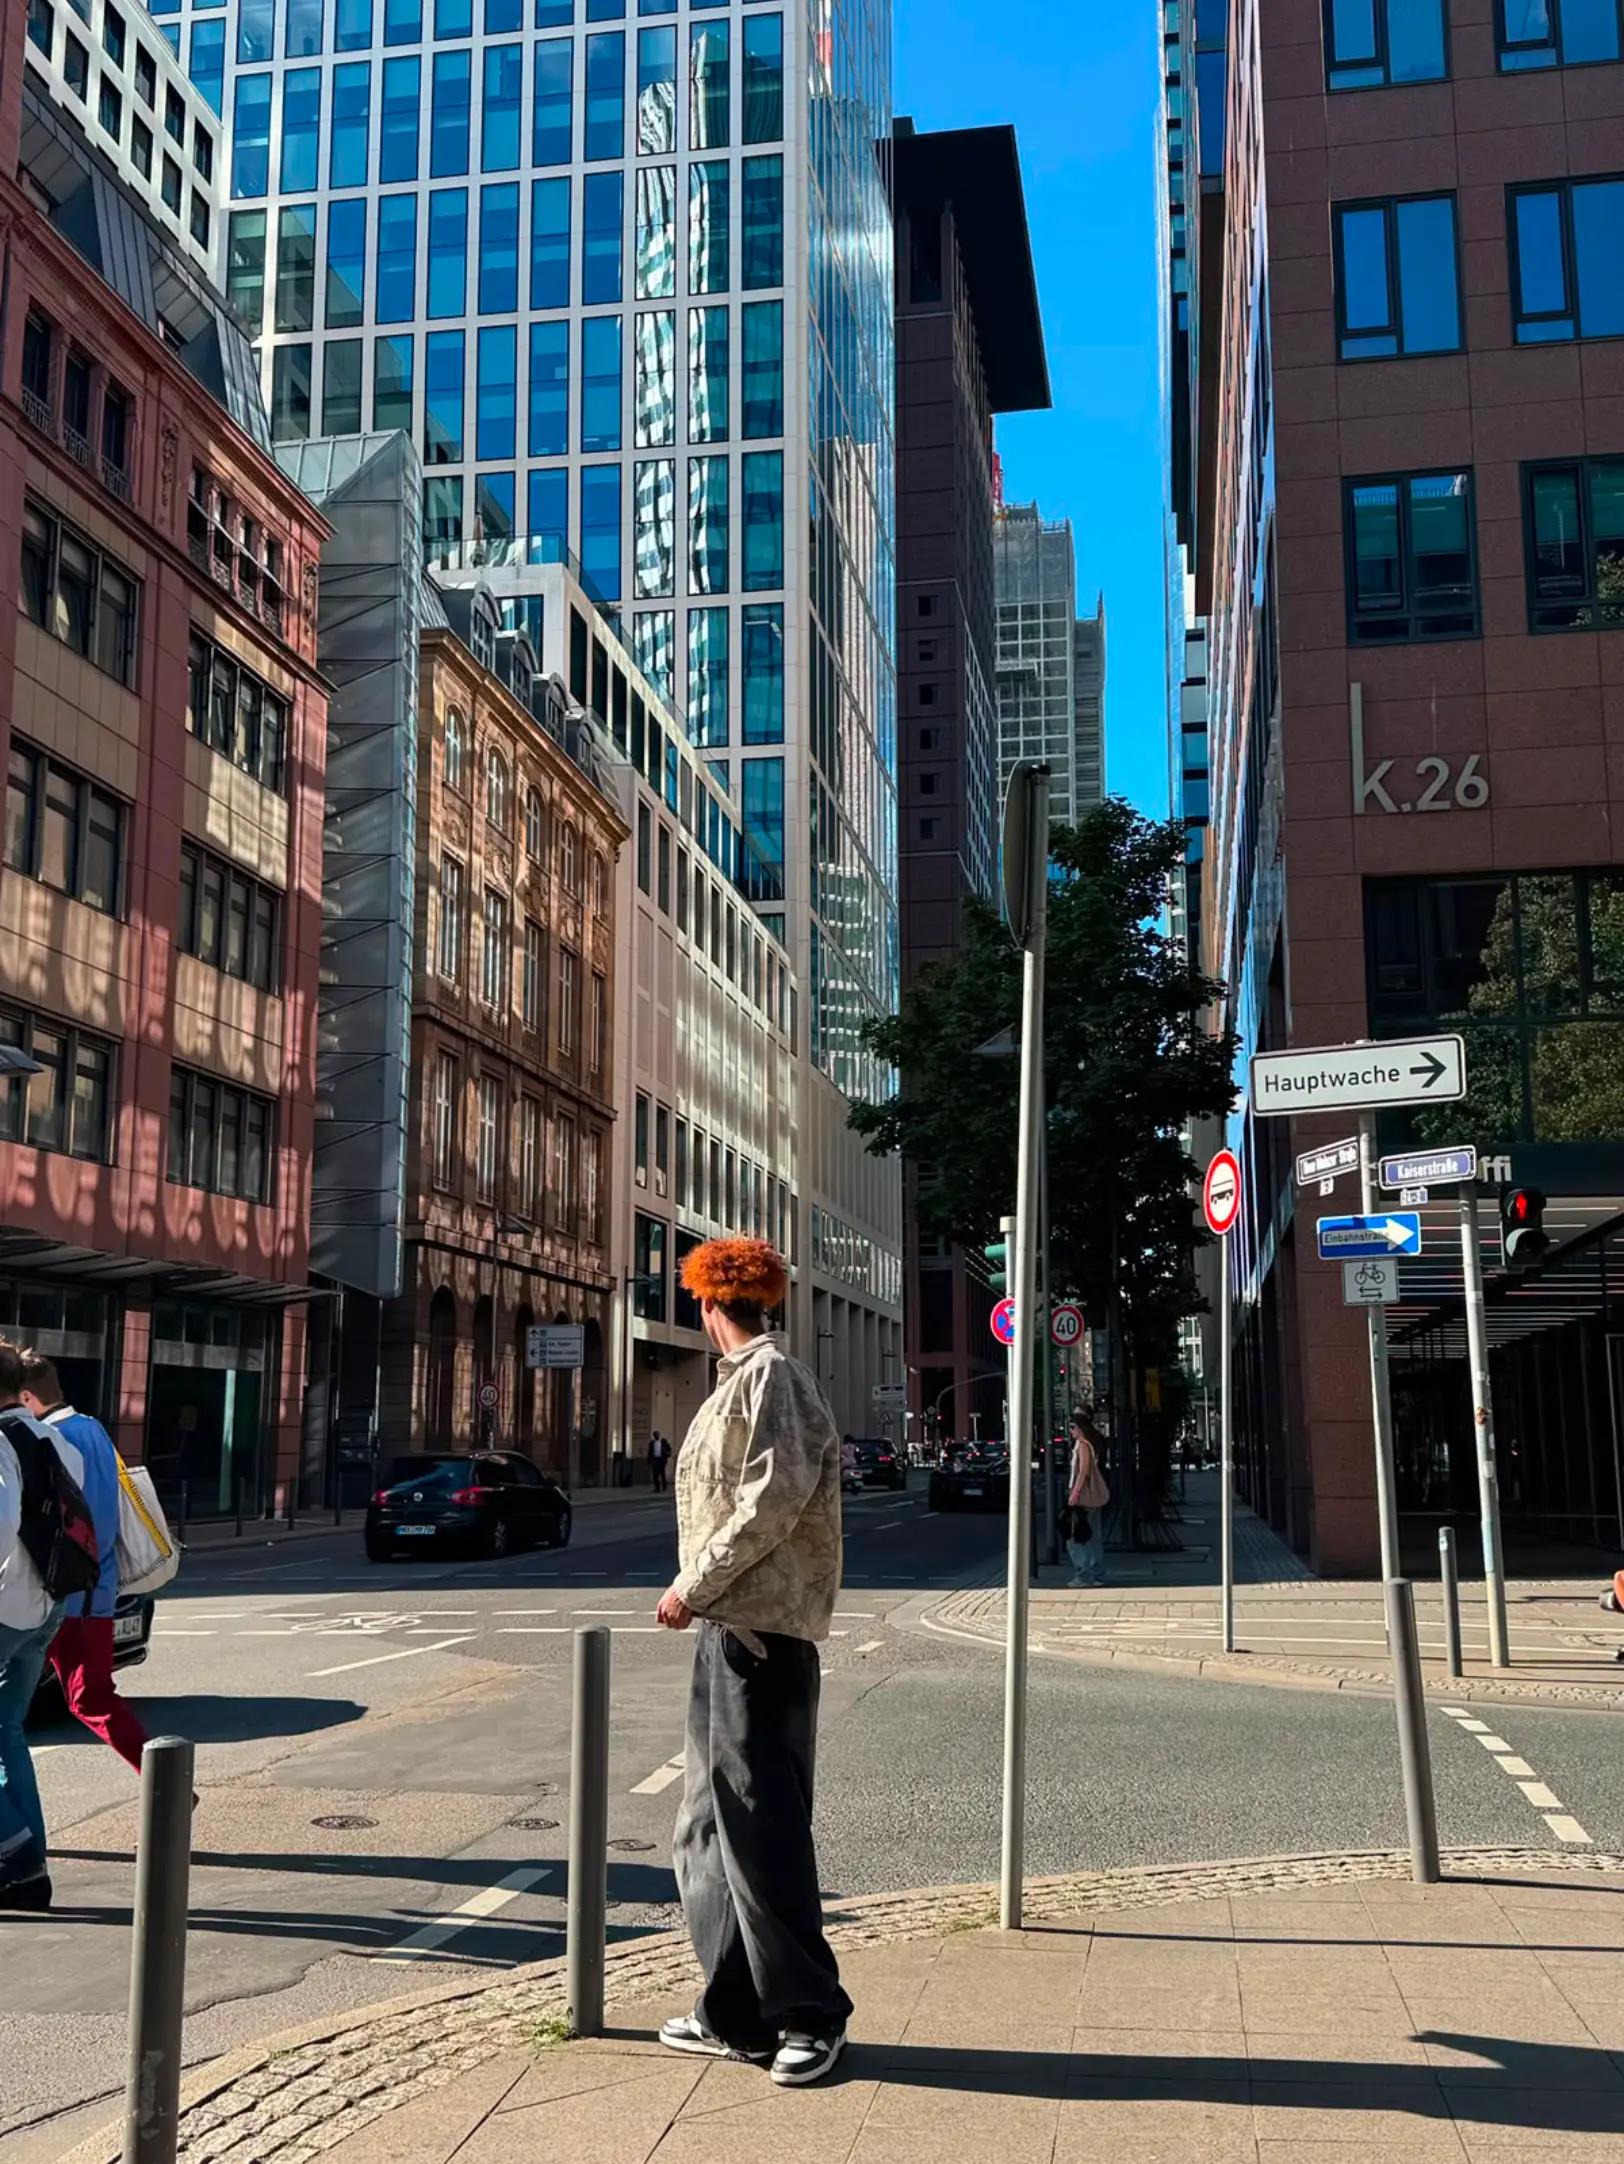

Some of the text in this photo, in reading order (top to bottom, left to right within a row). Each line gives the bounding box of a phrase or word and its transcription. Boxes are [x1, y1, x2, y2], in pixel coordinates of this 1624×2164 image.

[1350, 682, 1489, 815] k.26
[1264, 1066, 1401, 1095] Hauptwache
[1397, 1158, 1459, 1180] Kaiserstraße
[1056, 1316, 1076, 1335] 40
[482, 1389, 496, 1402] 40
